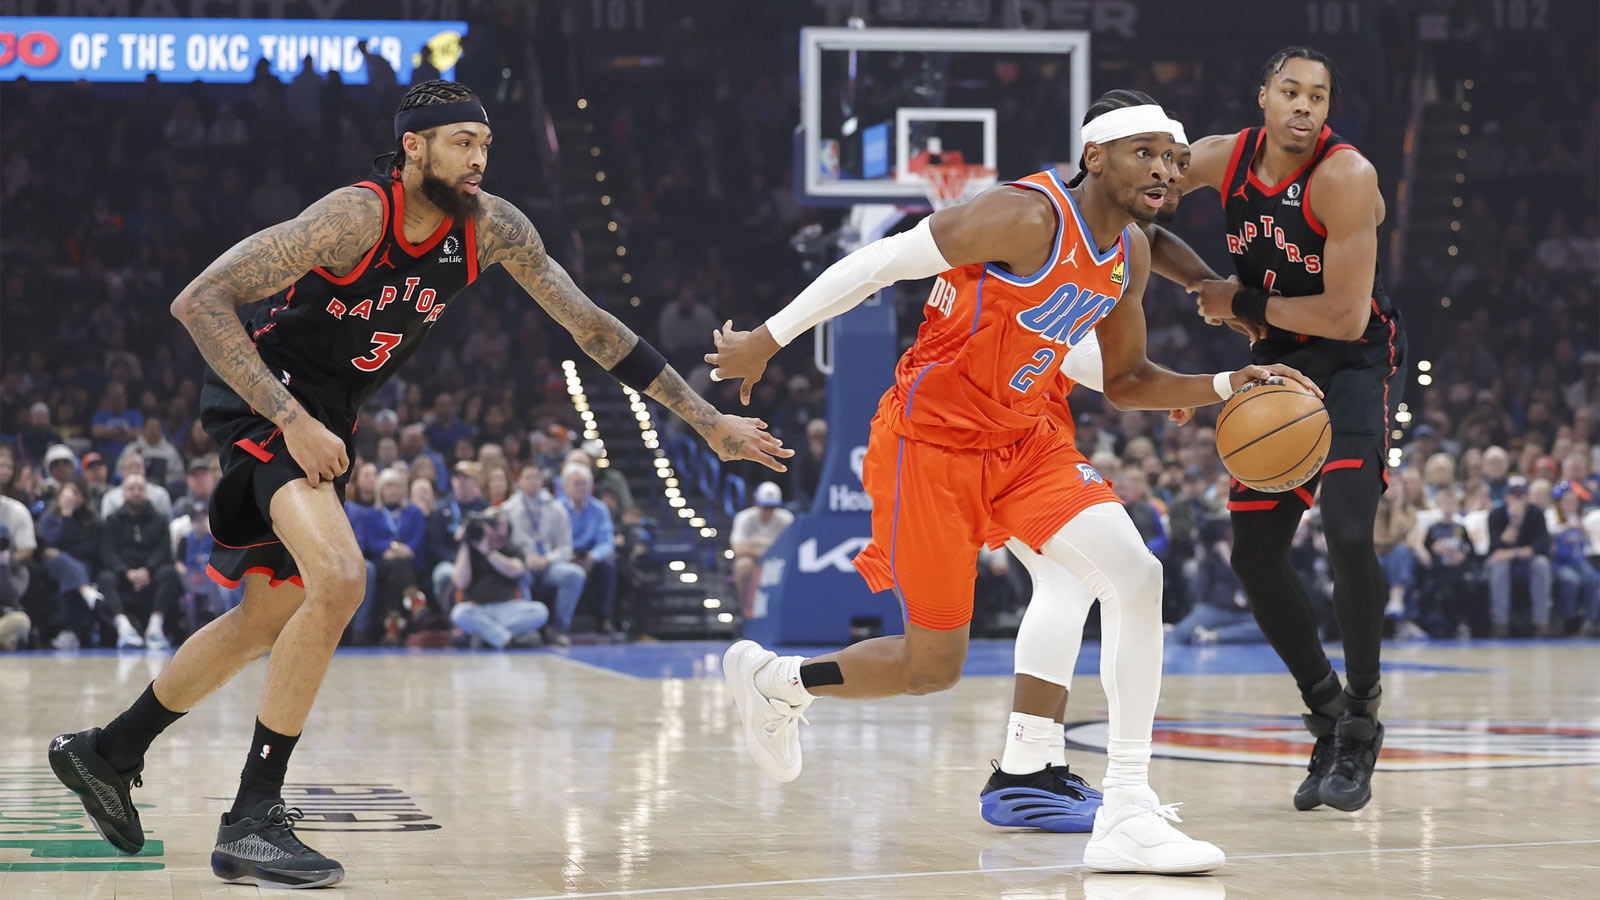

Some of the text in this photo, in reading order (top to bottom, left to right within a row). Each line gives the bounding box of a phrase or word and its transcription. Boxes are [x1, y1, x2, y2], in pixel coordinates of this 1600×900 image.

[1307, 1, 1359, 33] 101
[69, 32, 109, 71] OF
[118, 33, 176, 71] THE
[186, 33, 249, 72] OKC
[438, 255, 463, 264] Sun Life
[1226, 215, 1321, 273] RAPTORS
[1016, 282, 1117, 350] OKC
[351, 331, 403, 372] 3
[1008, 348, 1056, 394] 2
